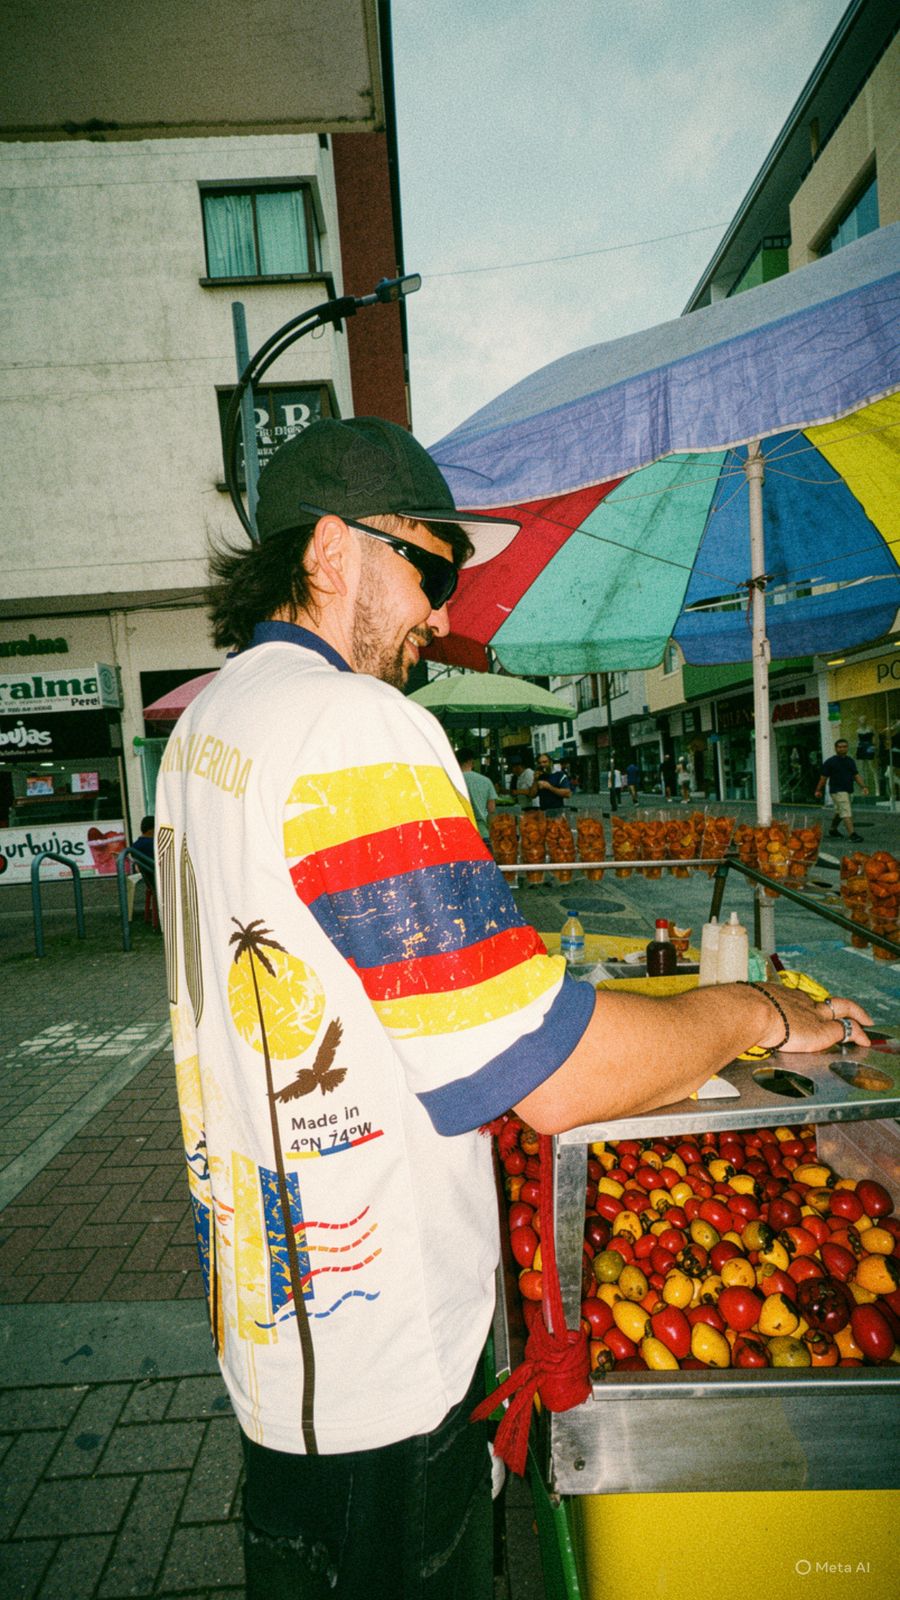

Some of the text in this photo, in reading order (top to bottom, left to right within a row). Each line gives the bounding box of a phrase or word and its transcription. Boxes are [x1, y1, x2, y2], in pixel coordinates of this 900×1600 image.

[0, 831, 86, 858] urbujas
[291, 1106, 360, 1131] Made in
